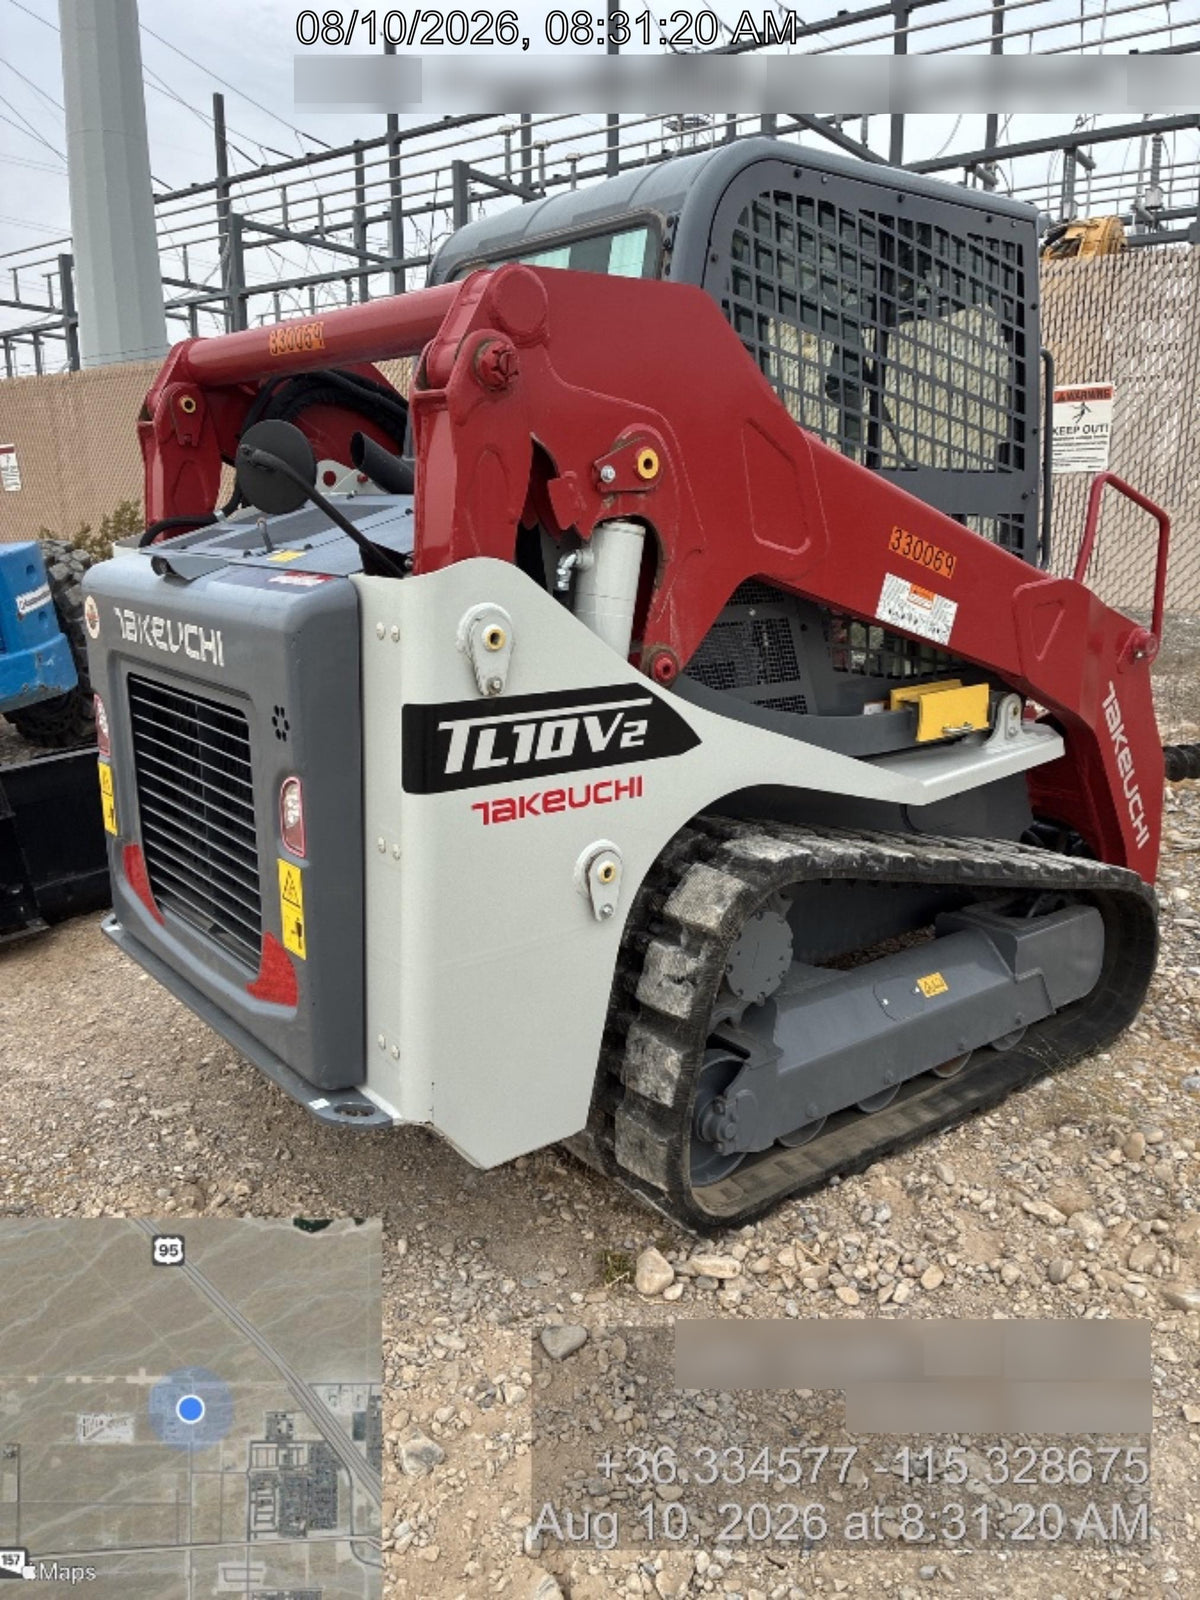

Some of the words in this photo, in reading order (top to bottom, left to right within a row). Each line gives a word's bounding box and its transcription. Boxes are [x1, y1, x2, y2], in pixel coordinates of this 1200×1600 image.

[1066, 388, 1111, 401] WARNING
[1082, 424, 1109, 434] OUT!
[891, 529, 954, 577] 330069
